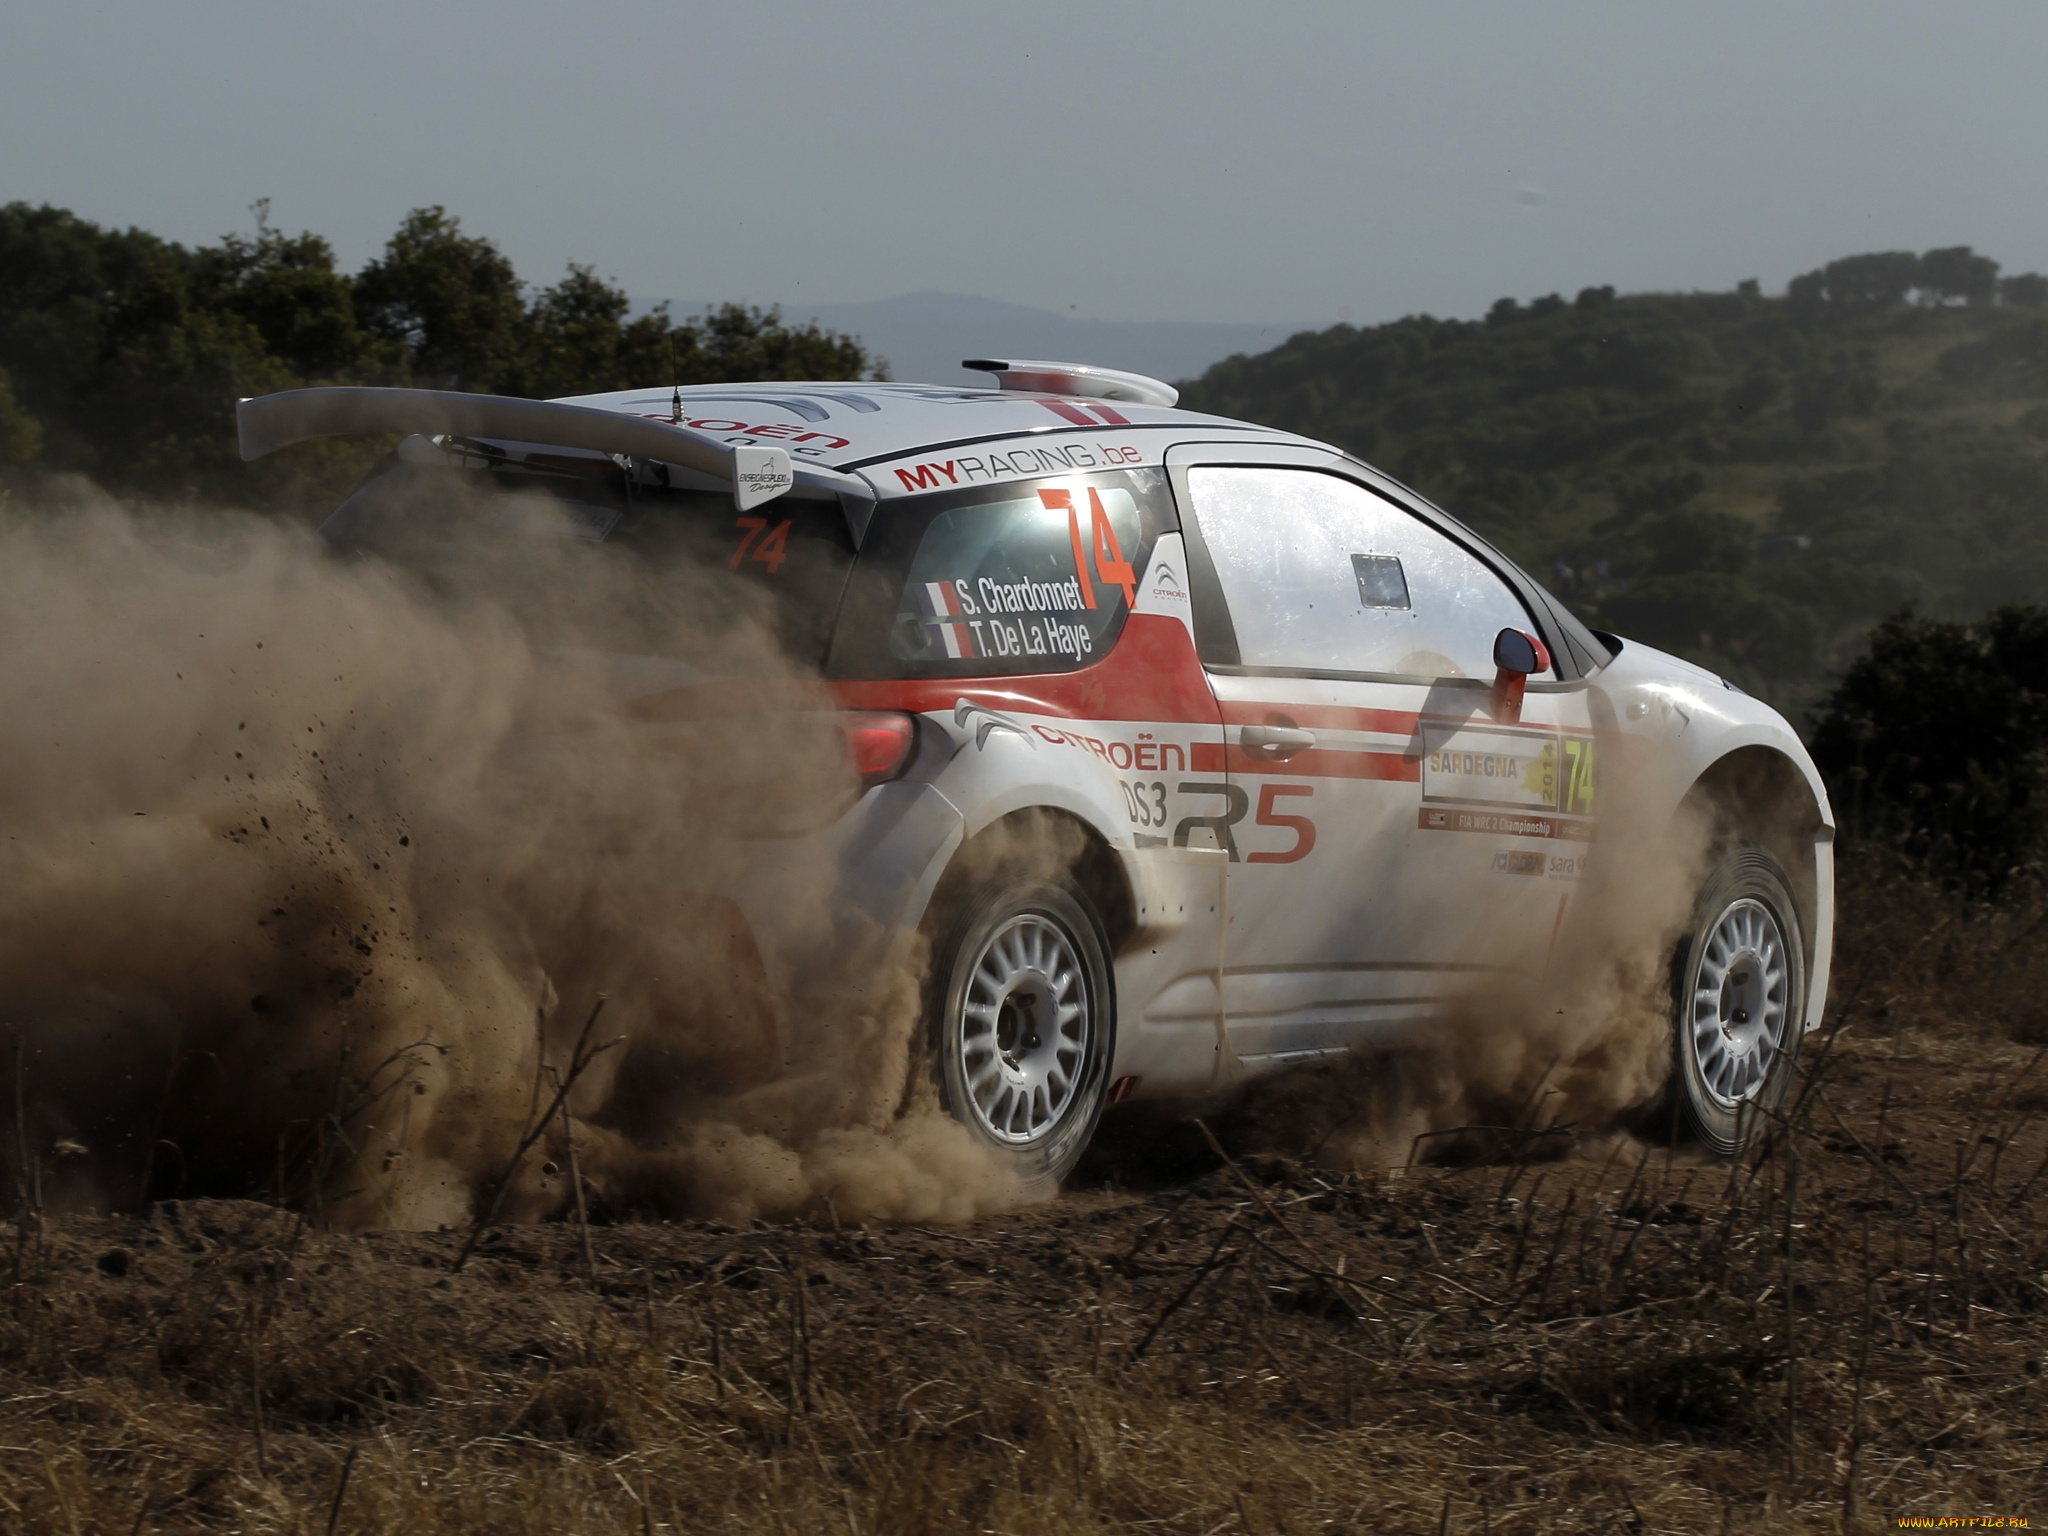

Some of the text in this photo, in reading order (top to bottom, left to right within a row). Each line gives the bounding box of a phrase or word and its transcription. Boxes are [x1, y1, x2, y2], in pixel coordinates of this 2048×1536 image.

[728, 517, 792, 573] 74
[1036, 486, 1138, 610] 74
[955, 574, 1086, 616] S. Chardonnet
[969, 616, 1093, 662] T. De La Haye
[1430, 751, 1518, 779] SARDEGNA
[1542, 743, 1554, 802] 2014
[1566, 740, 1594, 814] 74
[1119, 779, 1317, 864] DS3 R5
[1459, 814, 1550, 837] FIA WRC 2 Championship
[1549, 856, 1575, 874] sara
